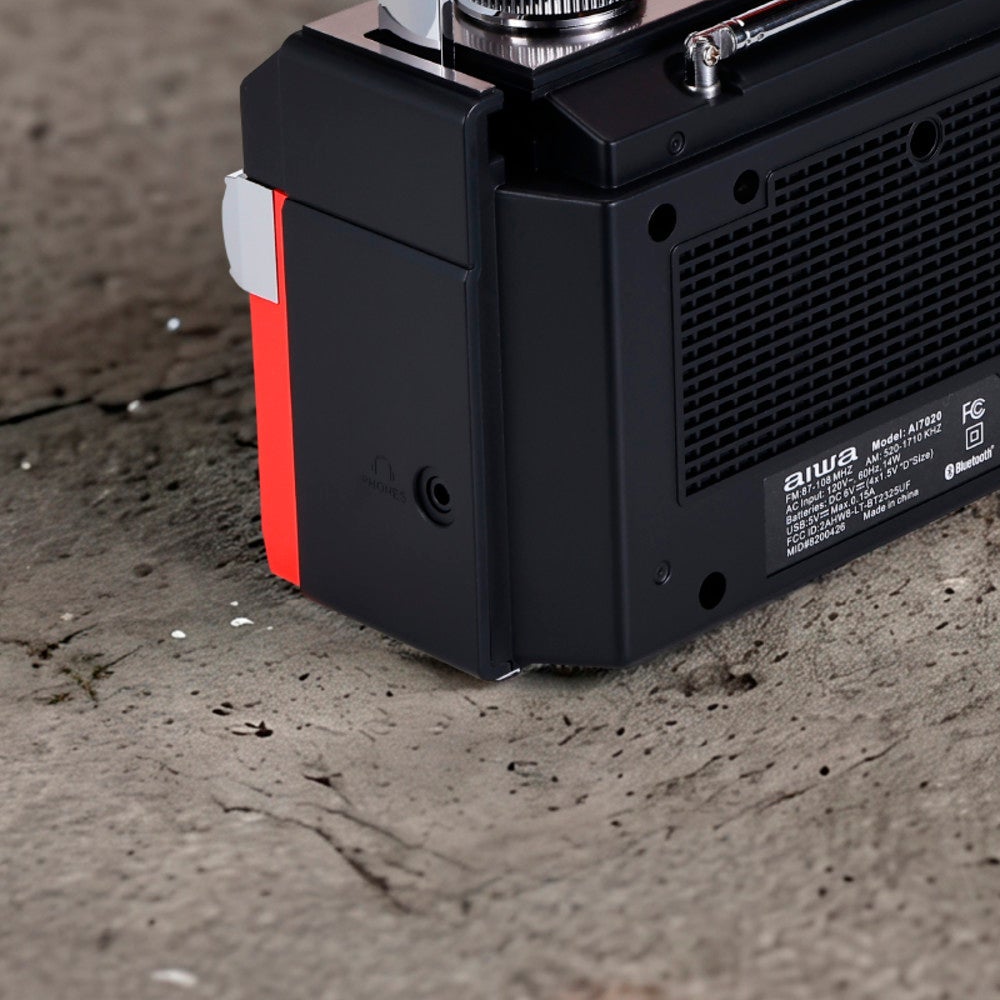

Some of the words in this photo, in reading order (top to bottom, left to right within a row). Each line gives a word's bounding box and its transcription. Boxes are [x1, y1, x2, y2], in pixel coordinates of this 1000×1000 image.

[865, 451, 881, 466] AM:
[924, 423, 941, 438] KHZ
[872, 427, 905, 451] Model:
[908, 410, 941, 434] AI7020
[784, 446, 858, 492] aiwa
[786, 501, 799, 514] AC
[883, 453, 900, 468] 14W
[833, 464, 852, 481] MHZ
[786, 498, 827, 525] Batteries:
[828, 491, 842, 505] DC
[863, 503, 885, 521] Made
[887, 498, 895, 509] in
[787, 529, 805, 546] FCC
